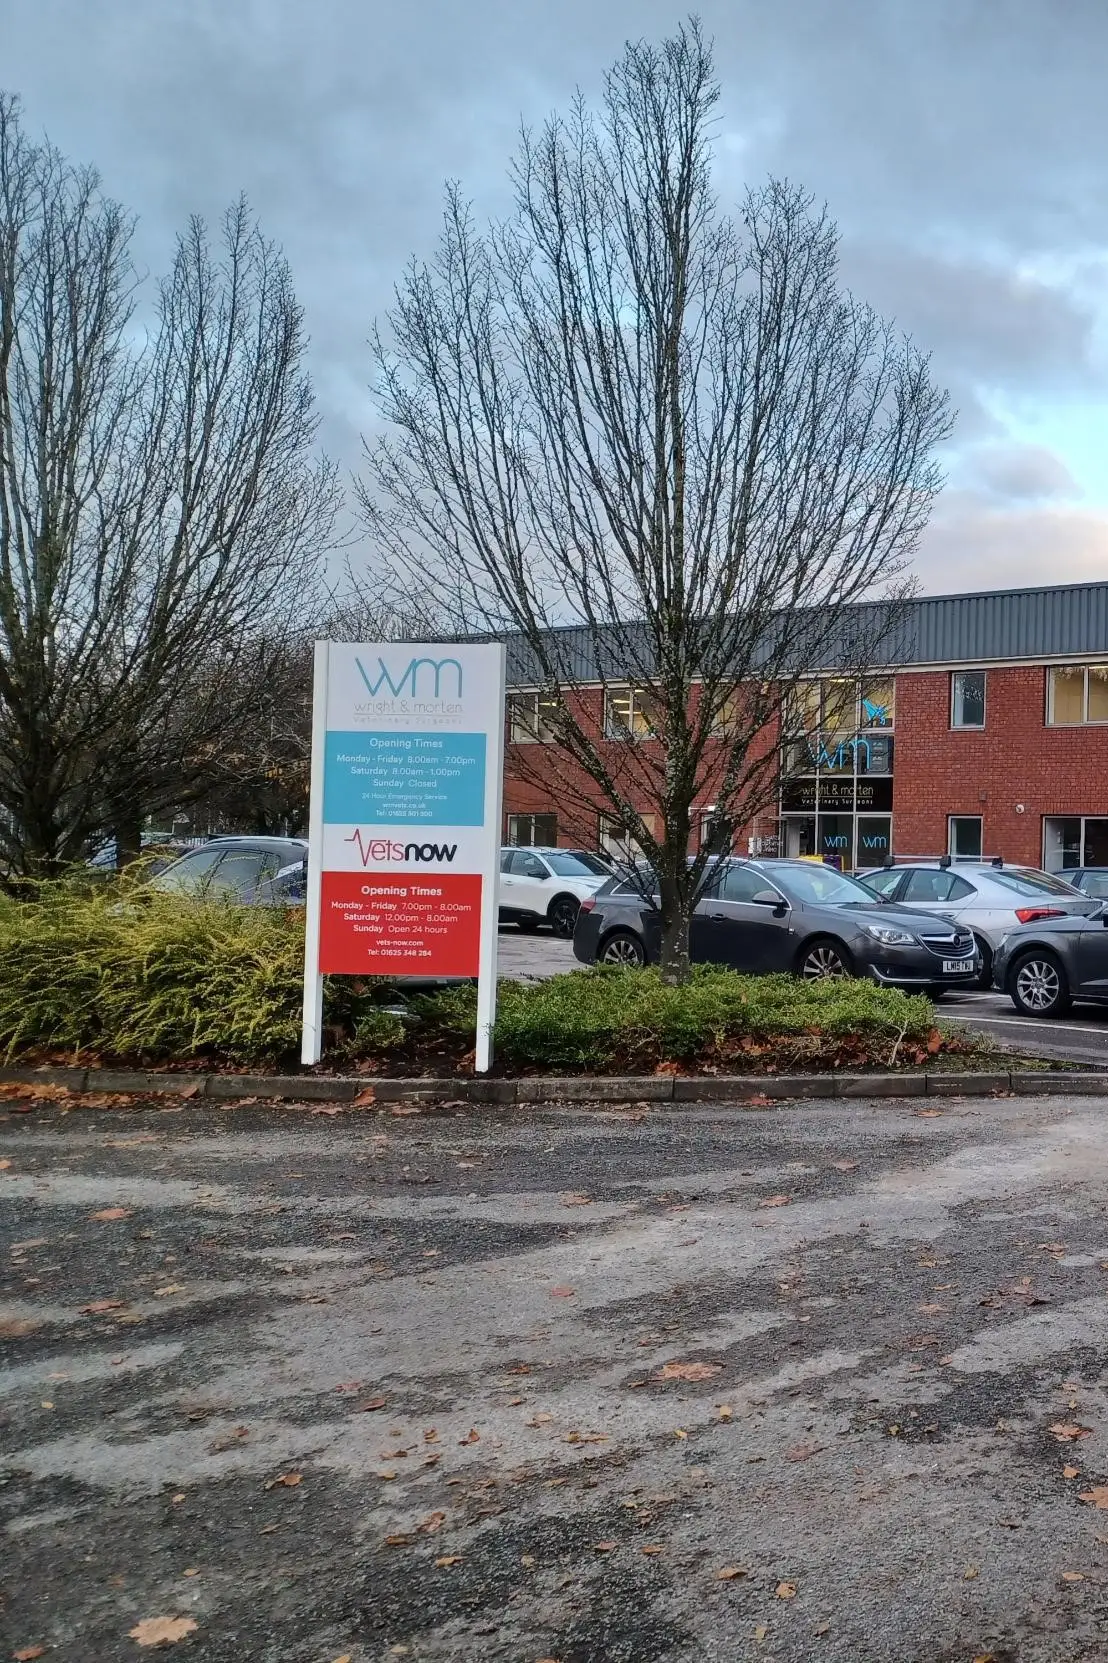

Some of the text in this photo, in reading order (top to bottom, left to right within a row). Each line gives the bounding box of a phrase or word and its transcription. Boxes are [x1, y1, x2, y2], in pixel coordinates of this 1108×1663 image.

[355, 657, 463, 698] wm
[354, 699, 463, 715] wright & morten
[369, 737, 443, 750] Opening Times
[336, 754, 371, 765] Monday
[377, 754, 404, 765] Friday
[350, 766, 388, 776] Saturday
[372, 778, 437, 789] Sunday Closed
[832, 784, 839, 795] &
[824, 835, 848, 848] wm
[862, 836, 887, 848] wm
[361, 885, 443, 898] Opening Times
[331, 901, 364, 911] Monday
[371, 902, 398, 911] Friday
[401, 902, 433, 912] 7.00pm
[440, 903, 472, 911] 8.00am
[344, 913, 380, 923] Saturday
[384, 913, 419, 923] 12.00pm
[426, 914, 458, 922] 8.00am
[353, 924, 448, 934] Sunday Open 24 hours
[376, 938, 424, 947] vets-now.com
